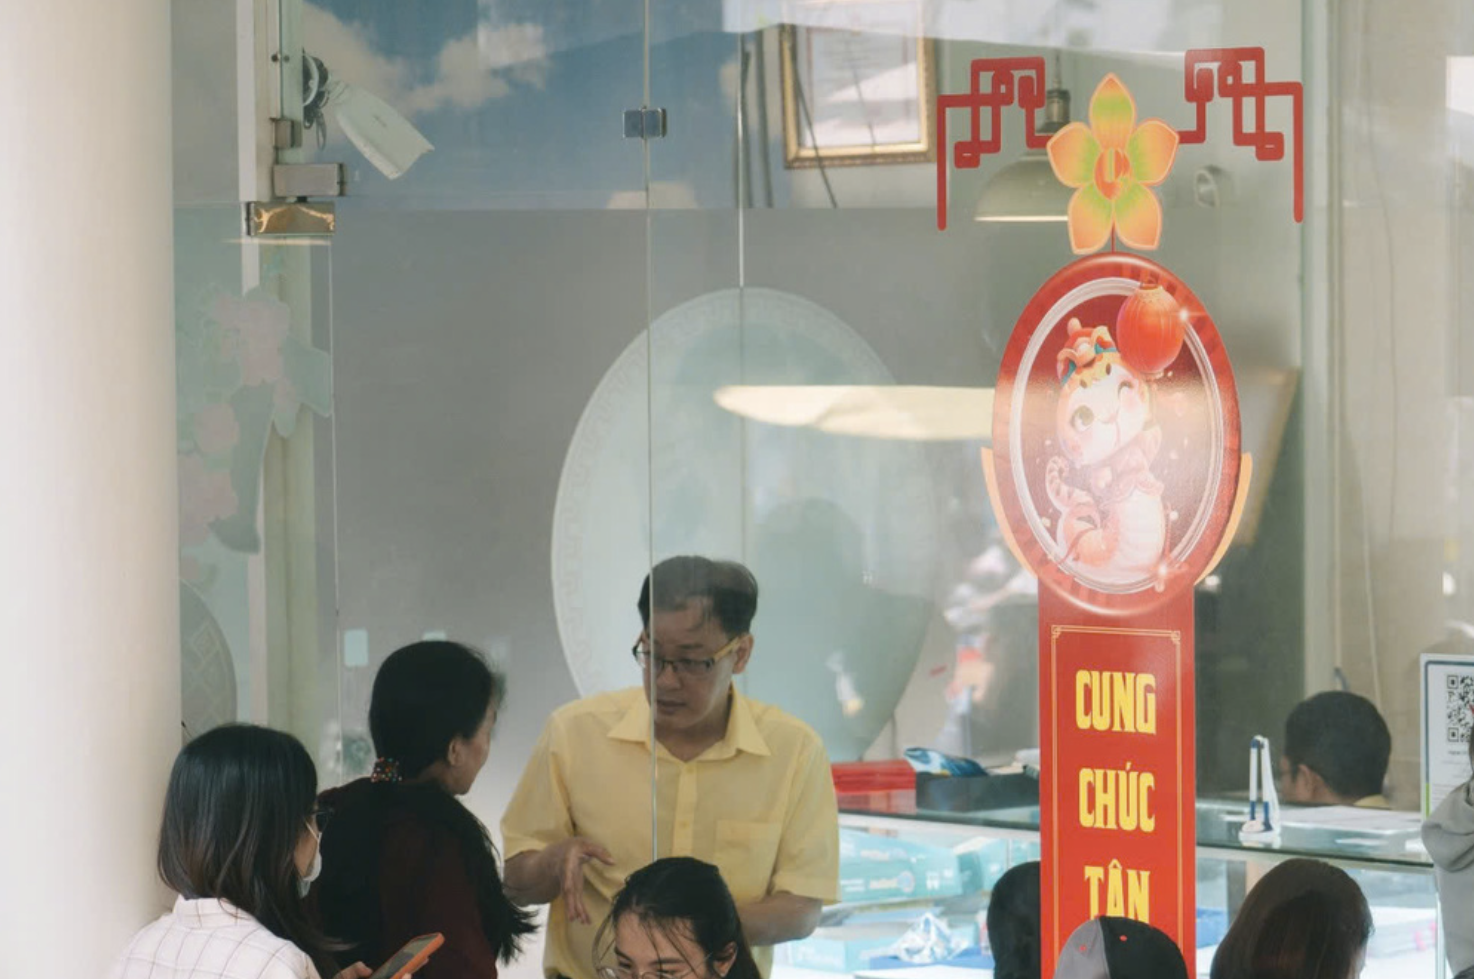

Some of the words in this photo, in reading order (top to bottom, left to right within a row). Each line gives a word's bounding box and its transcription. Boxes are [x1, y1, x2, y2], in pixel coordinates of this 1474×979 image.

[1075, 669, 1157, 735] CUNG
[1078, 761, 1156, 833] CHÚC
[1084, 858, 1151, 924] TÂN
